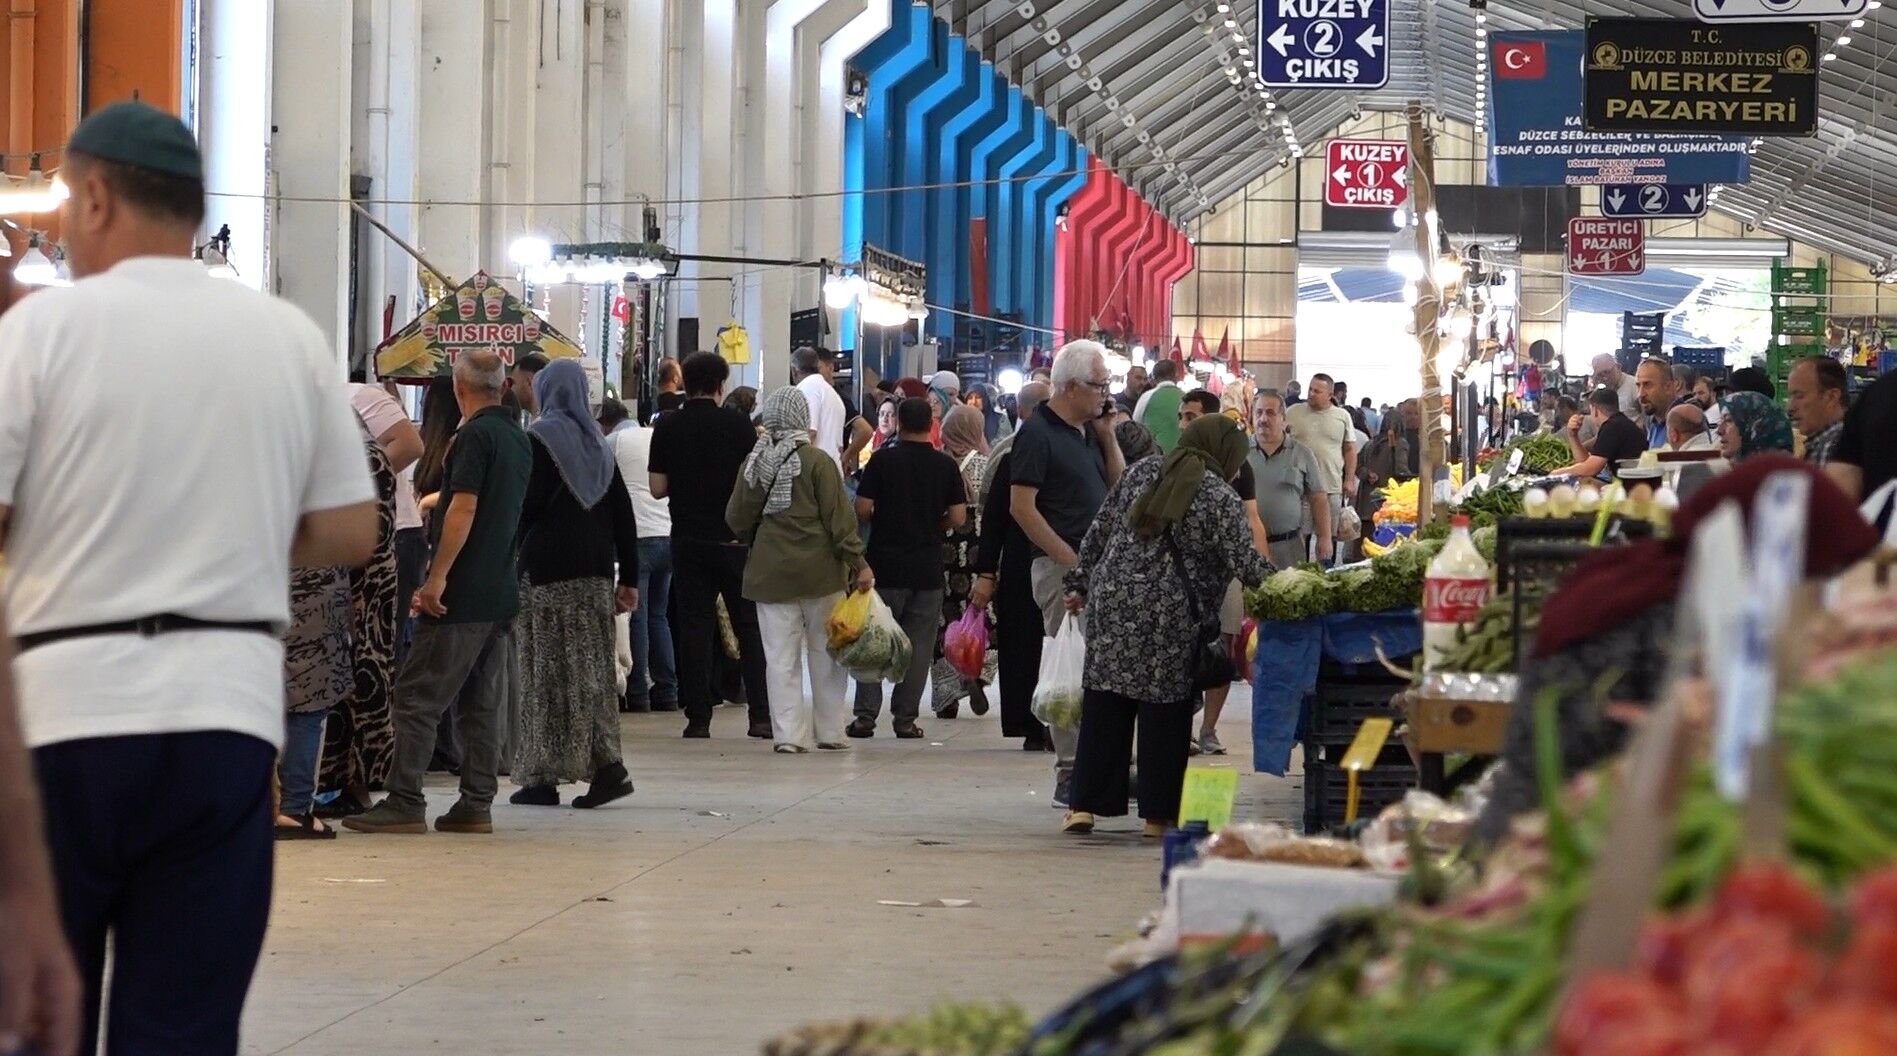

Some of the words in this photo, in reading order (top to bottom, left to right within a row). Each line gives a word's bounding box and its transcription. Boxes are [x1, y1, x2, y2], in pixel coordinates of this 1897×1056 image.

[1278, 0, 1372, 18] KUZEY
[1313, 23, 1334, 53] 2
[1691, 30, 1722, 43] T.C.
[1622, 48, 1676, 64] DÜZCE
[1681, 49, 1783, 67] BELEDİYESİ
[1285, 58, 1359, 82] ÇIKIŞ
[1630, 71, 1772, 93] MERKEZ
[1606, 97, 1796, 122] PAZARYERİ
[1519, 130, 1557, 141] DÜZCE
[1341, 145, 1405, 161] KUZEY
[1493, 145, 1533, 155] ESNAF
[1535, 144, 1572, 155] ODASI
[1575, 143, 1656, 156] ÜYELERİNDEN
[1659, 143, 1747, 154] OLUŞMAKTADIR
[1638, 159, 1665, 167] ADINA
[1363, 165, 1375, 185] 1
[1566, 175, 1592, 184] İSLAM
[1345, 188, 1394, 205] ÇIKIŞ
[1645, 187, 1663, 209] 2
[1575, 221, 1638, 234] ÜRETİCİ
[1582, 238, 1632, 249] PAZARI
[439, 324, 524, 343] MISIRCI
